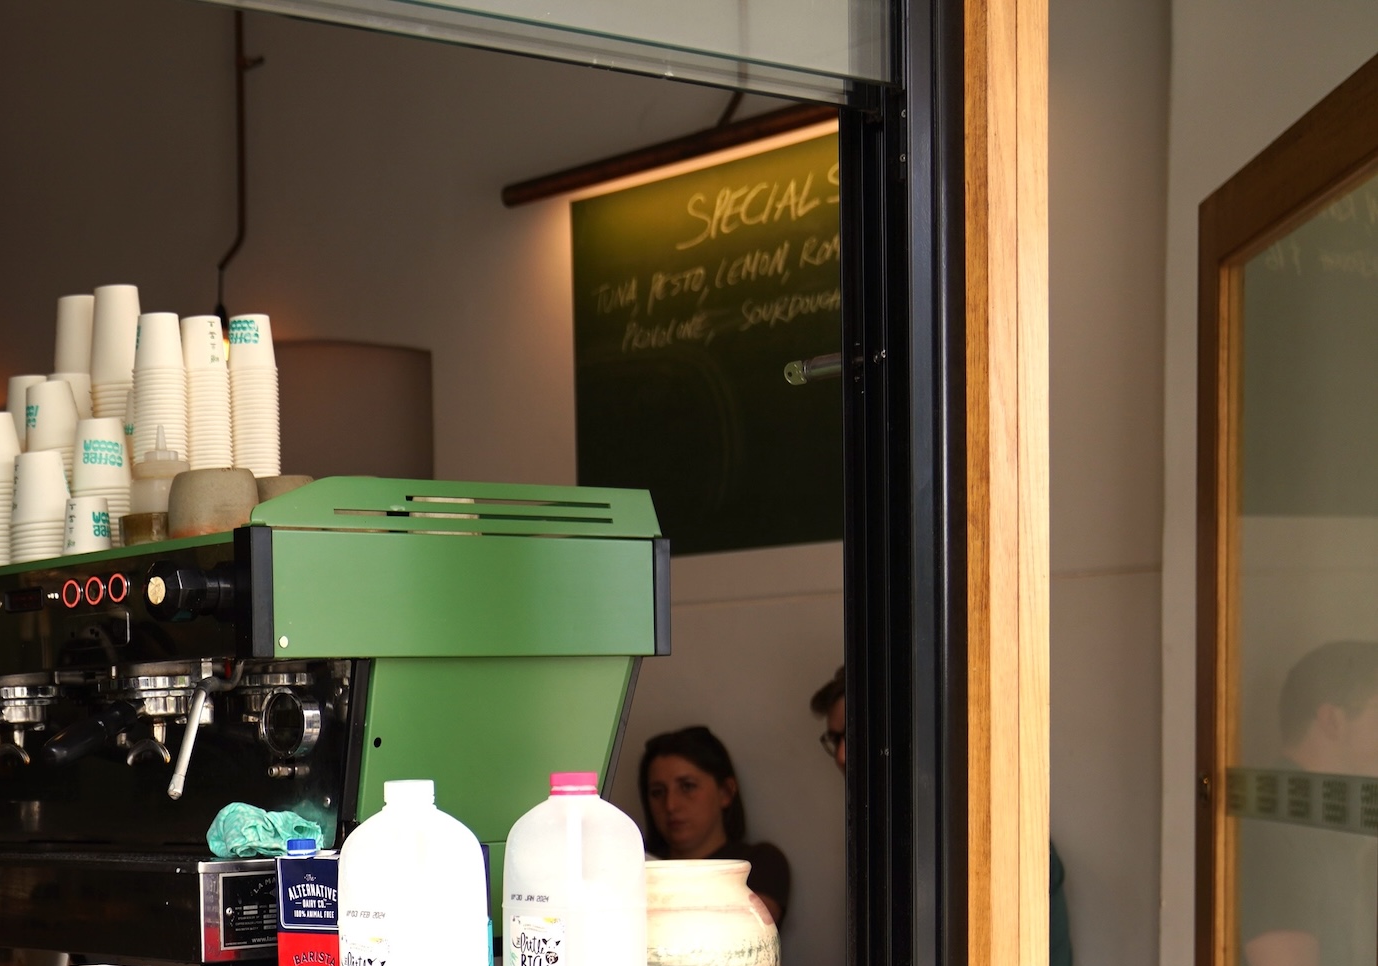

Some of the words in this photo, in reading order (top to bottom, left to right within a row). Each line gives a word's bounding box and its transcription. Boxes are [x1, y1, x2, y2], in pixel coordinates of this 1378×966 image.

[287, 883, 337, 902] ALTERNATIVE
[302, 899, 316, 908] DAIRY
[307, 910, 323, 919] ANIMAL
[324, 911, 335, 919] FREE
